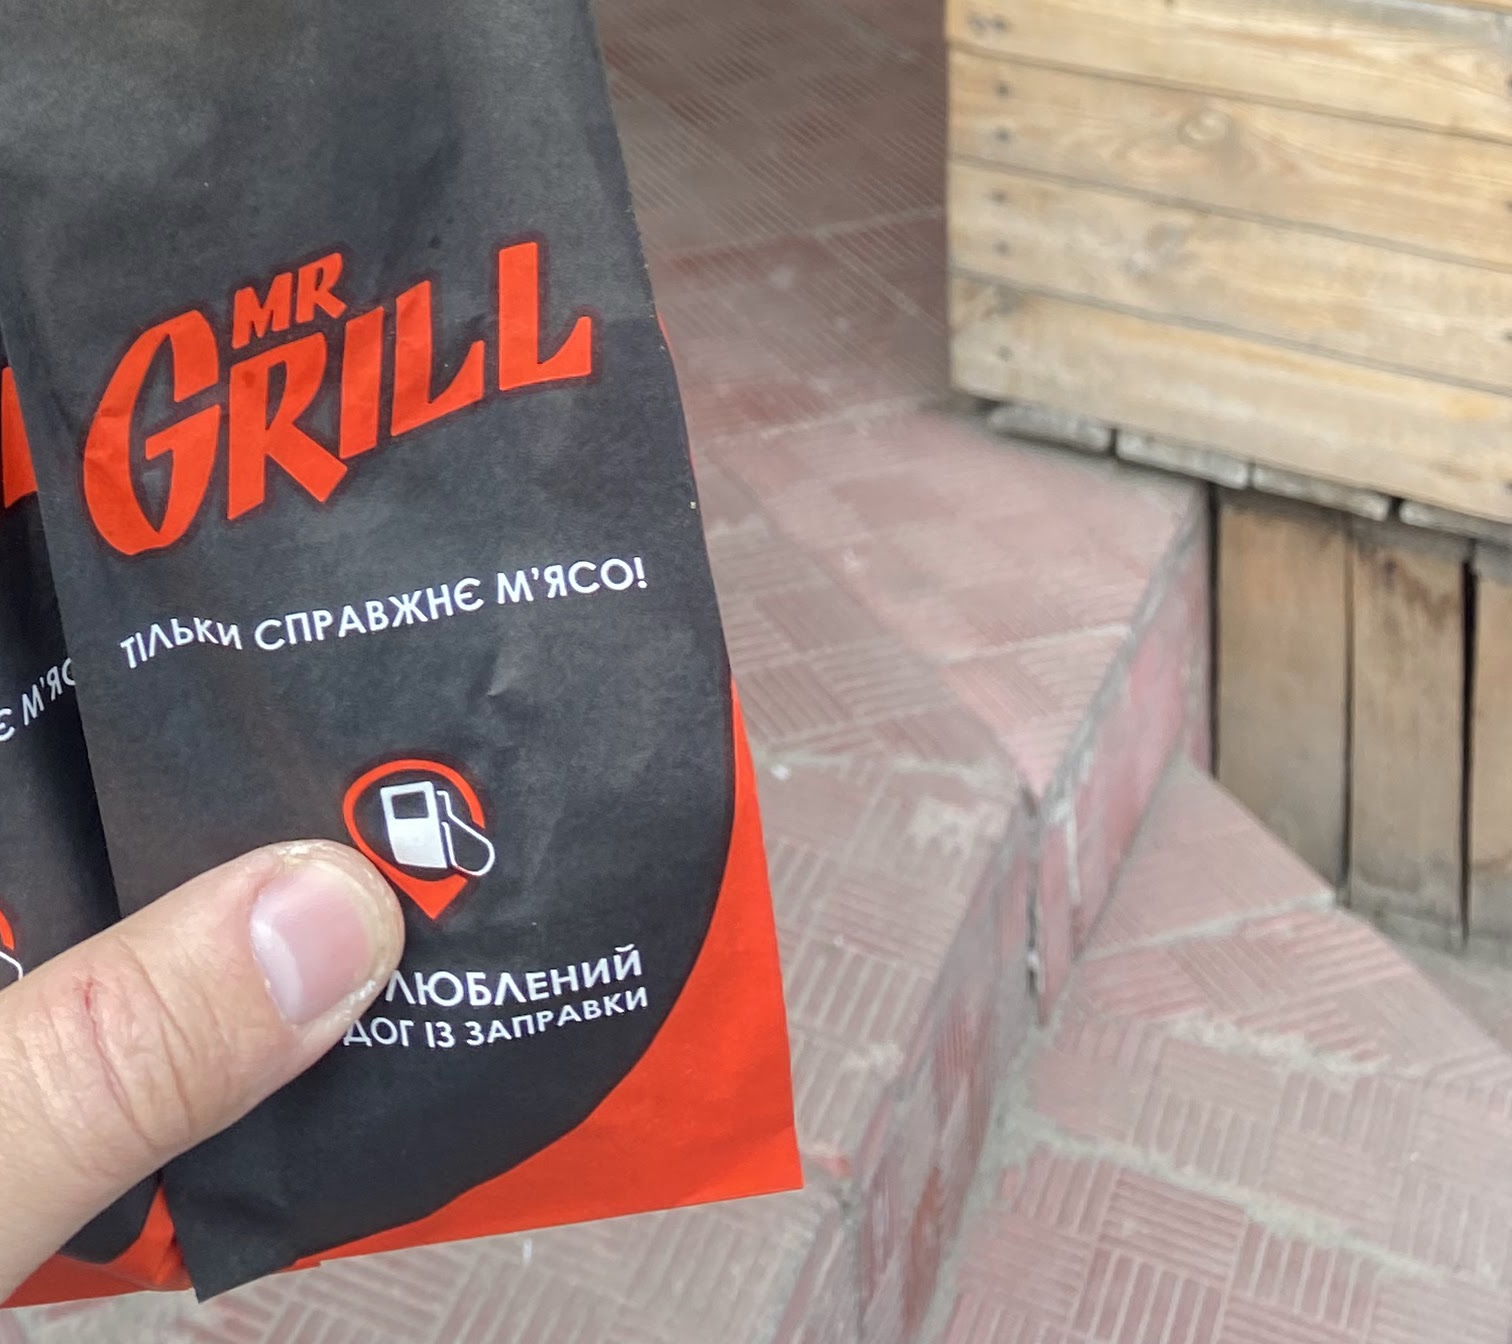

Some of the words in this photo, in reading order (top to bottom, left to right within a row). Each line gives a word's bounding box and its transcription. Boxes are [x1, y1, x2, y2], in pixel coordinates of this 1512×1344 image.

[231, 252, 348, 350] MR
[83, 241, 593, 556] GRILL
[119, 618, 244, 669] ТІЛЬКИ
[254, 576, 484, 652] СПРАВЖНЄ
[497, 555, 649, 606] М'ЯСО!
[21, 657, 76, 726] М'ЯС
[386, 943, 643, 1006] ЛЮБЛЕНИЙ
[343, 1017, 413, 1048] ДОГ
[426, 1020, 456, 1048] ІЗ
[466, 986, 649, 1046] ЗАПРАВКИ
